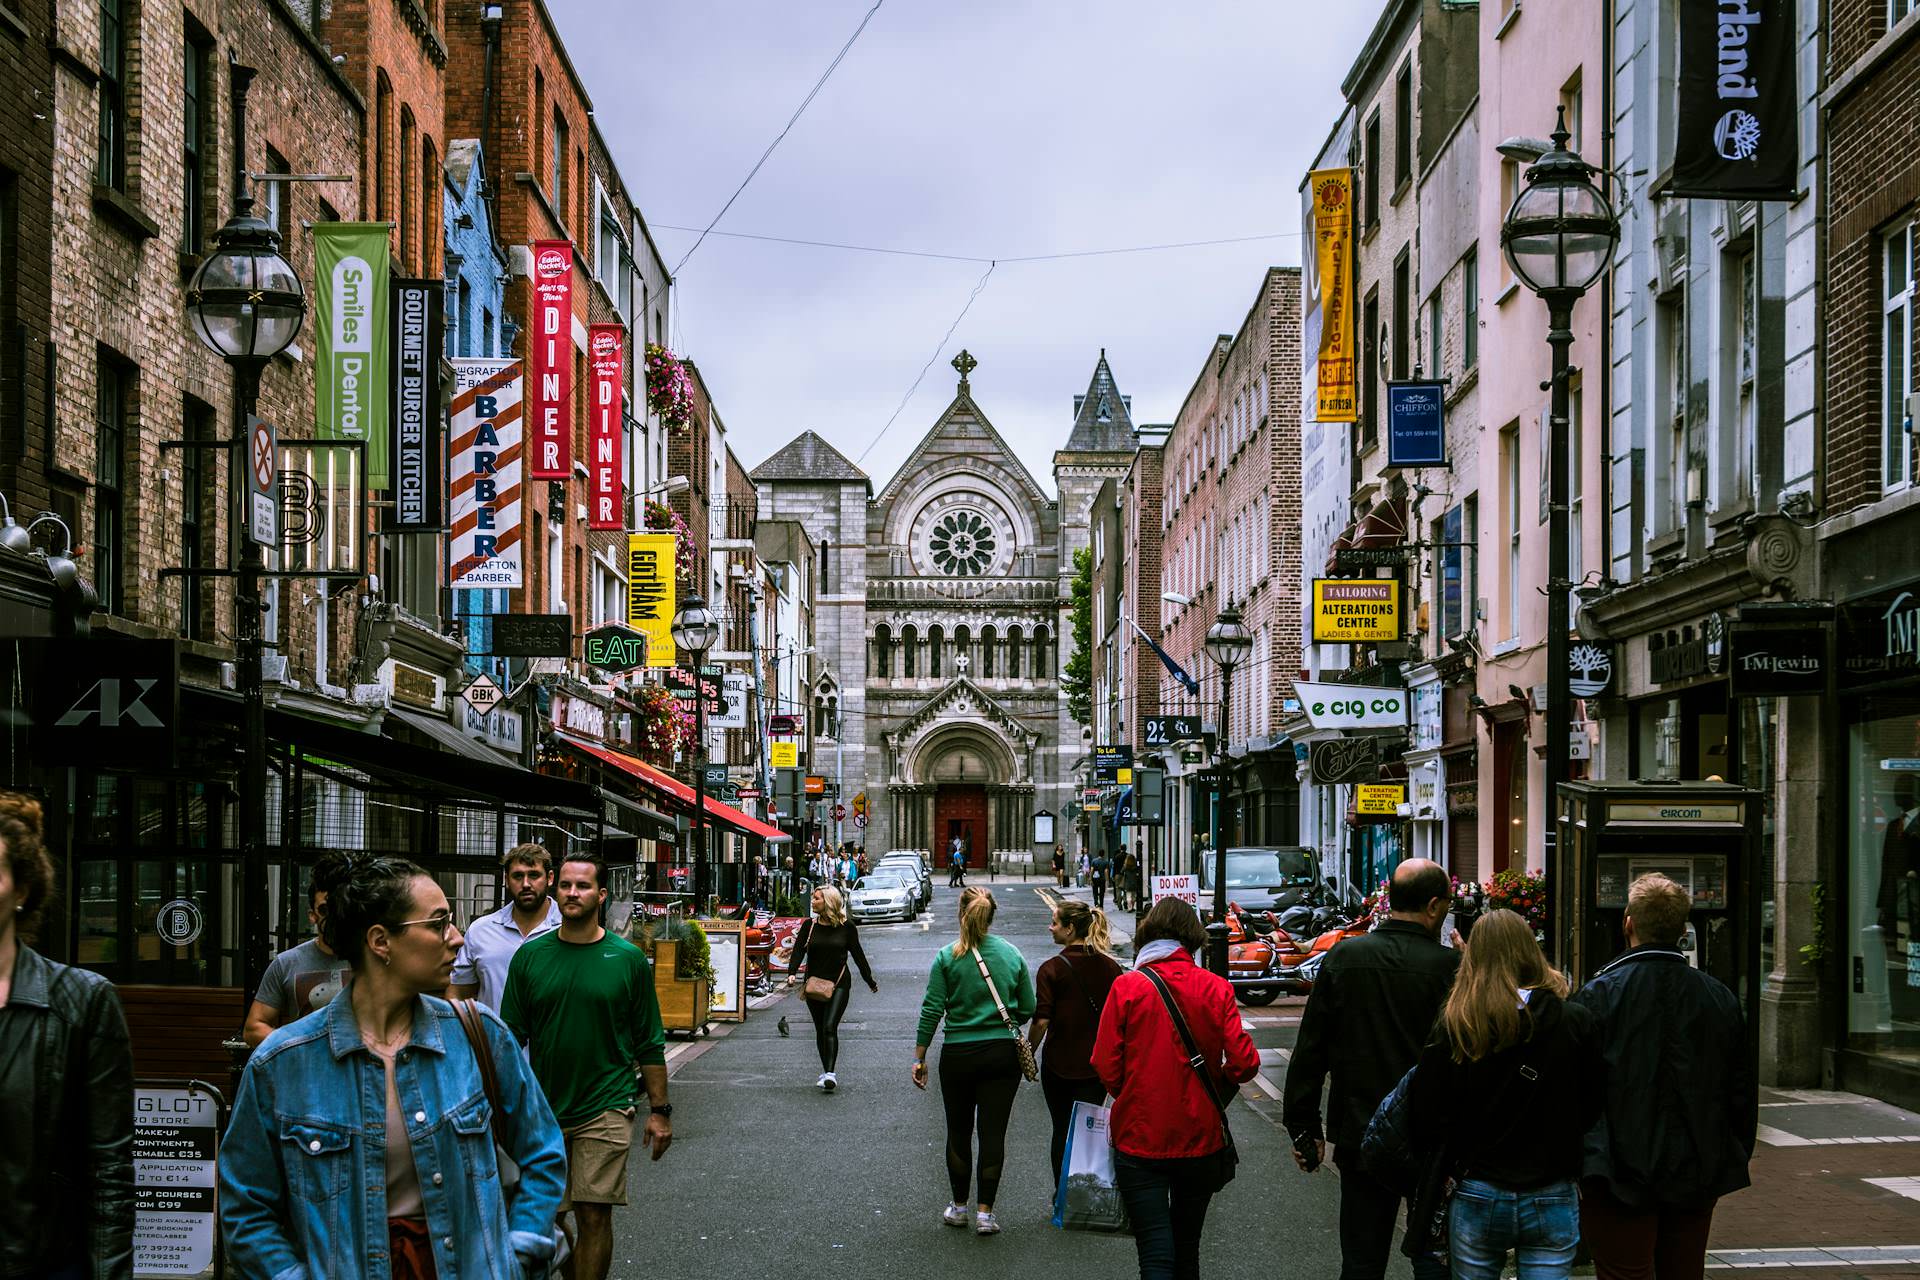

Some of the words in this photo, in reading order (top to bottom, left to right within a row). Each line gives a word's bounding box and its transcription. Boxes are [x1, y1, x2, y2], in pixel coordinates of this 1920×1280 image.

[541, 256, 561, 264] Eddie
[1331, 241, 1342, 354] ALTERATION
[342, 269, 364, 344] Smiles
[402, 288, 421, 375] GOURMET
[595, 337, 613, 345] Eddie
[457, 367, 466, 386] THE
[466, 366, 518, 376] GRAFTON
[1321, 361, 1352, 384] CENTRE
[468, 380, 512, 389] BARBER
[543, 307, 560, 470] DINER
[342, 357, 364, 438] Dental
[402, 377, 421, 444] BURGER
[1394, 404, 1437, 412] CHIFFON
[599, 381, 613, 521] DINER
[474, 395, 499, 557] BARBER
[402, 448, 421, 524] KITCHEN
[465, 561, 517, 570] GRAFTON
[467, 573, 512, 582] BARBER
[631, 550, 666, 620] GOTHAM
[1327, 587, 1387, 598] TAILORING
[1322, 603, 1393, 615] ALTERATIONS
[501, 621, 565, 633] GRAFTON
[1337, 616, 1378, 629] CENTRE
[1321, 631, 1352, 639] LADIES
[1354, 631, 1362, 639] &
[1363, 631, 1393, 639] GENTS
[503, 636, 560, 649] BARBER
[588, 636, 642, 664] EAT
[472, 689, 494, 700] GBK
[54, 679, 165, 727] AK
[1311, 702, 1325, 716] e
[1330, 699, 1366, 718] cig
[1370, 699, 1400, 714] co
[706, 771, 725, 781] SO
[829, 809, 846, 817] SOP
[1159, 878, 1171, 889] DO
[1173, 877, 1189, 889] NOT
[1177, 893, 1197, 904] THIS
[178, 1150, 202, 1158] €35
[166, 1174, 189, 1182] €14
